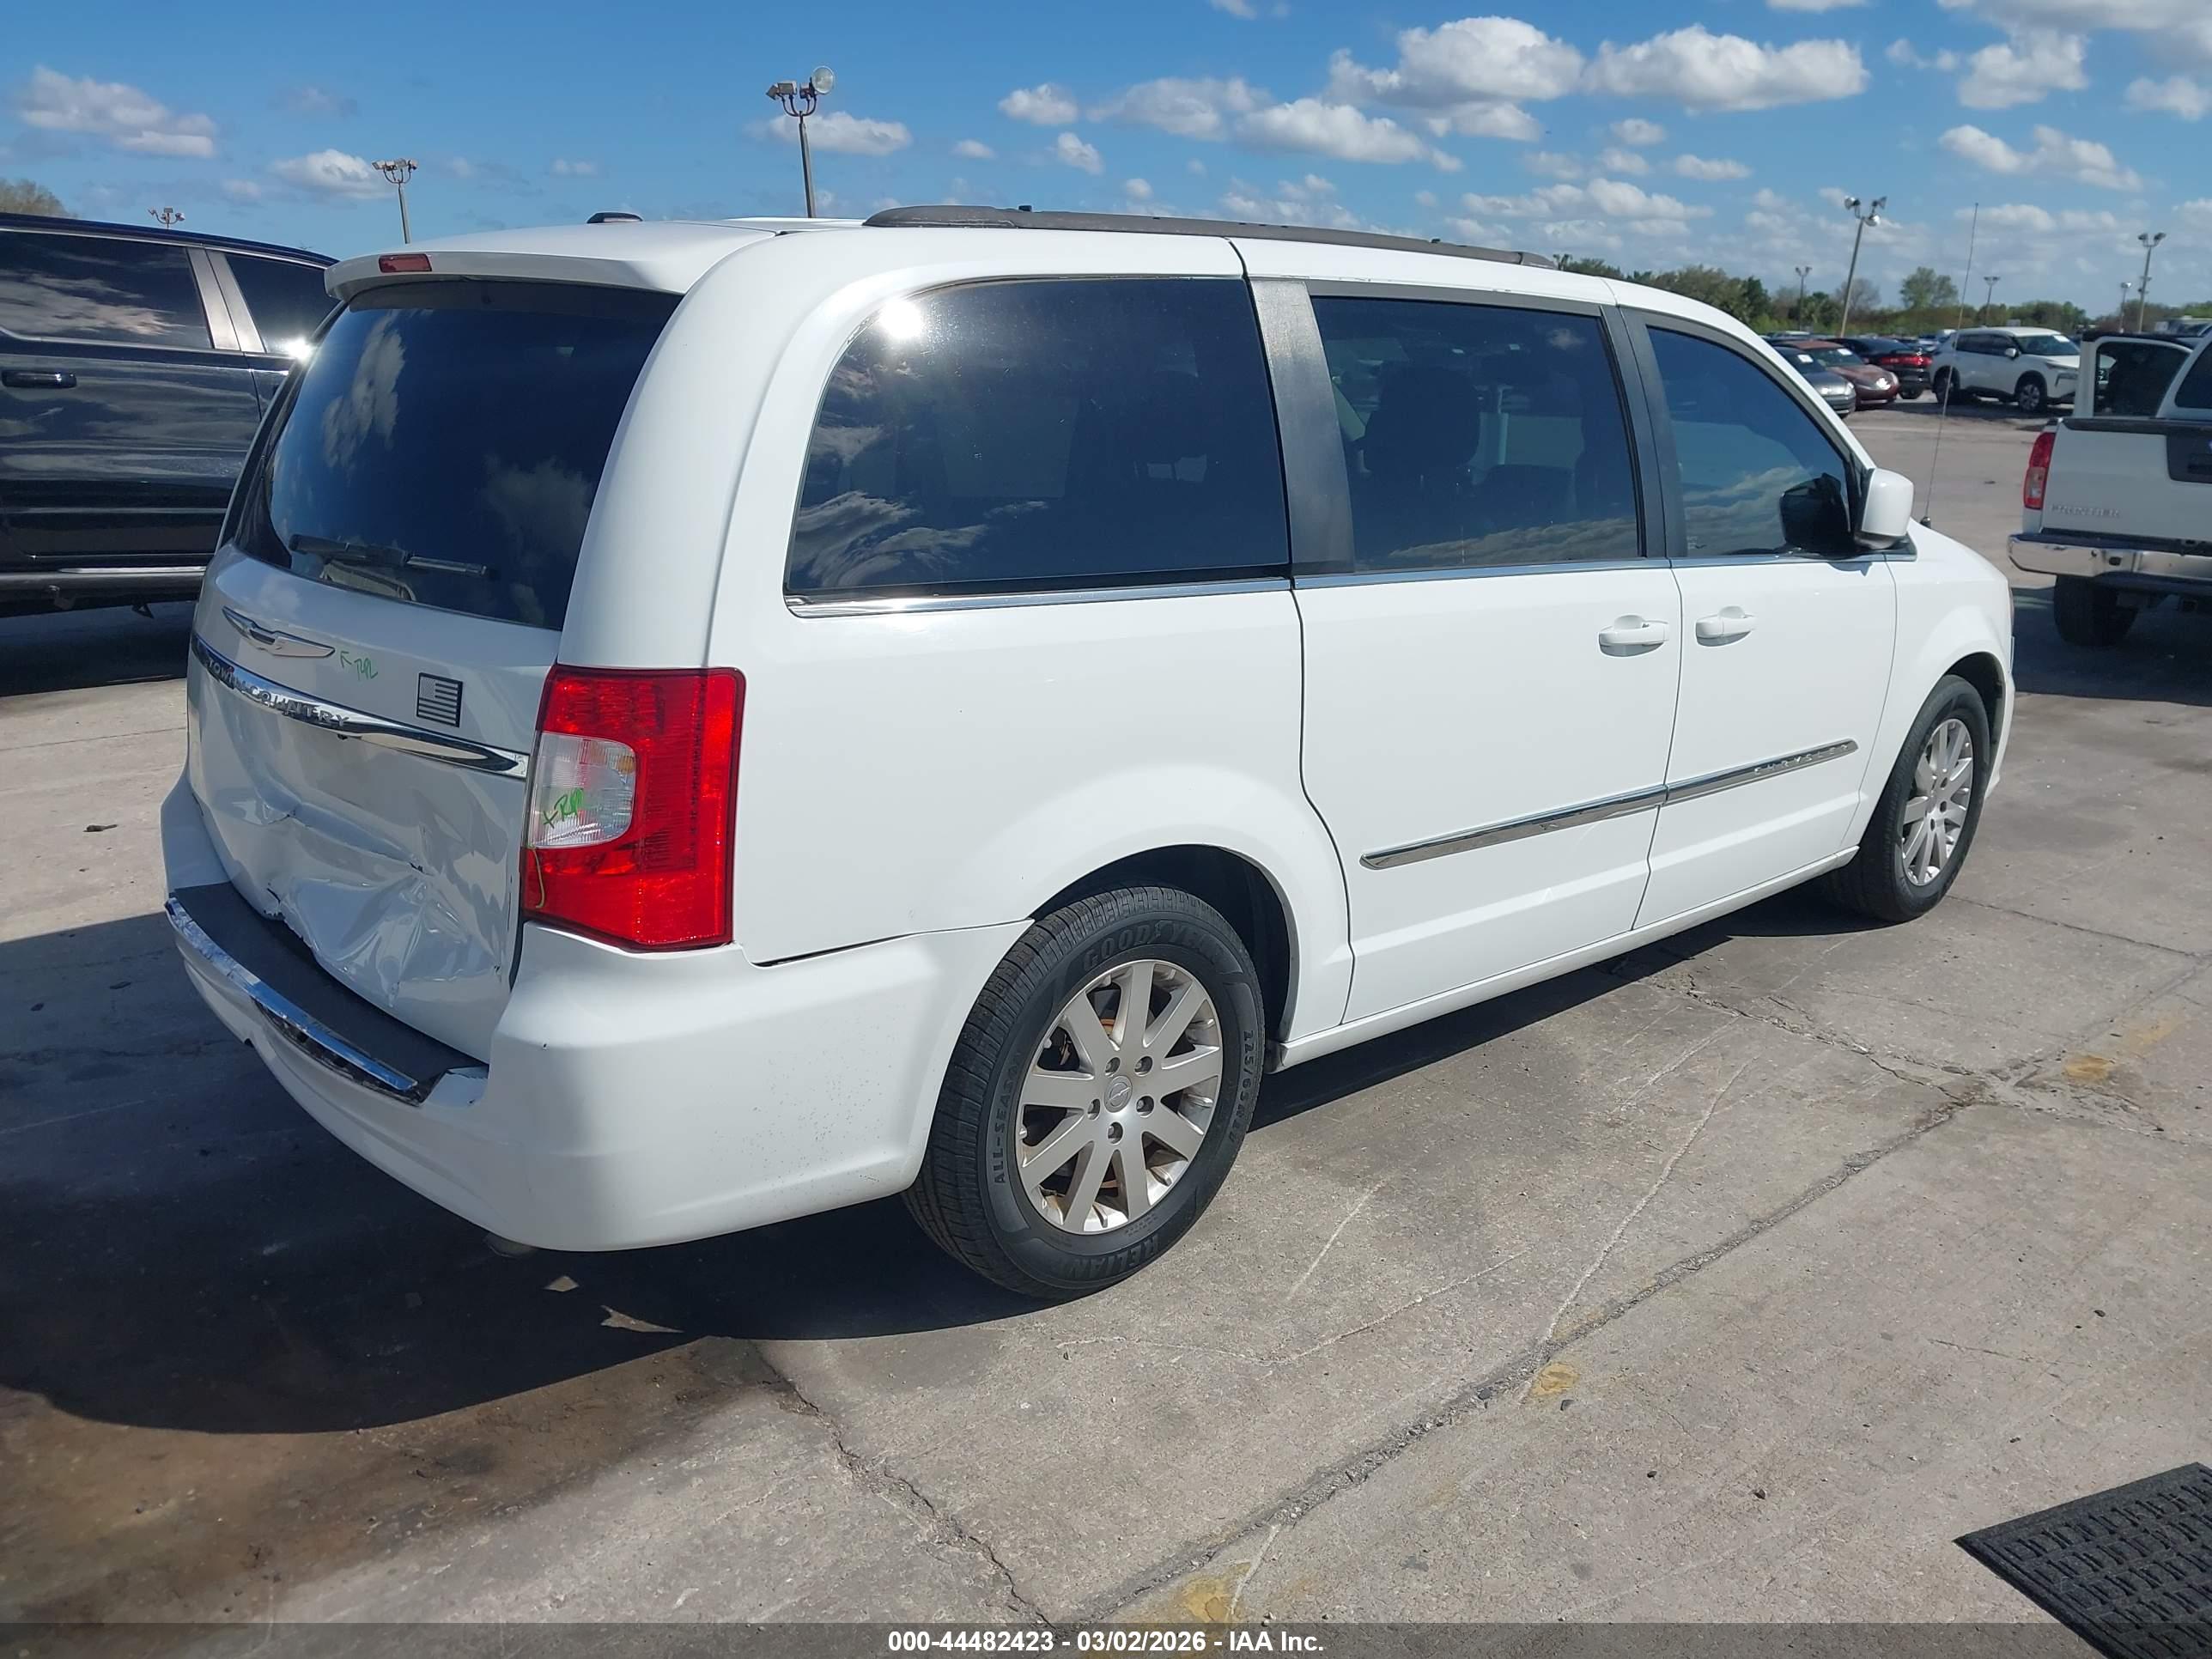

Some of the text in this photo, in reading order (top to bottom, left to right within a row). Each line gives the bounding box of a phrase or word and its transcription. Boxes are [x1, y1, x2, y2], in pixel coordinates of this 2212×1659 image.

[208, 658, 240, 687] TOWN
[249, 684, 349, 727] COUNTRY
[1061, 1235, 1158, 1278] RELIAN
